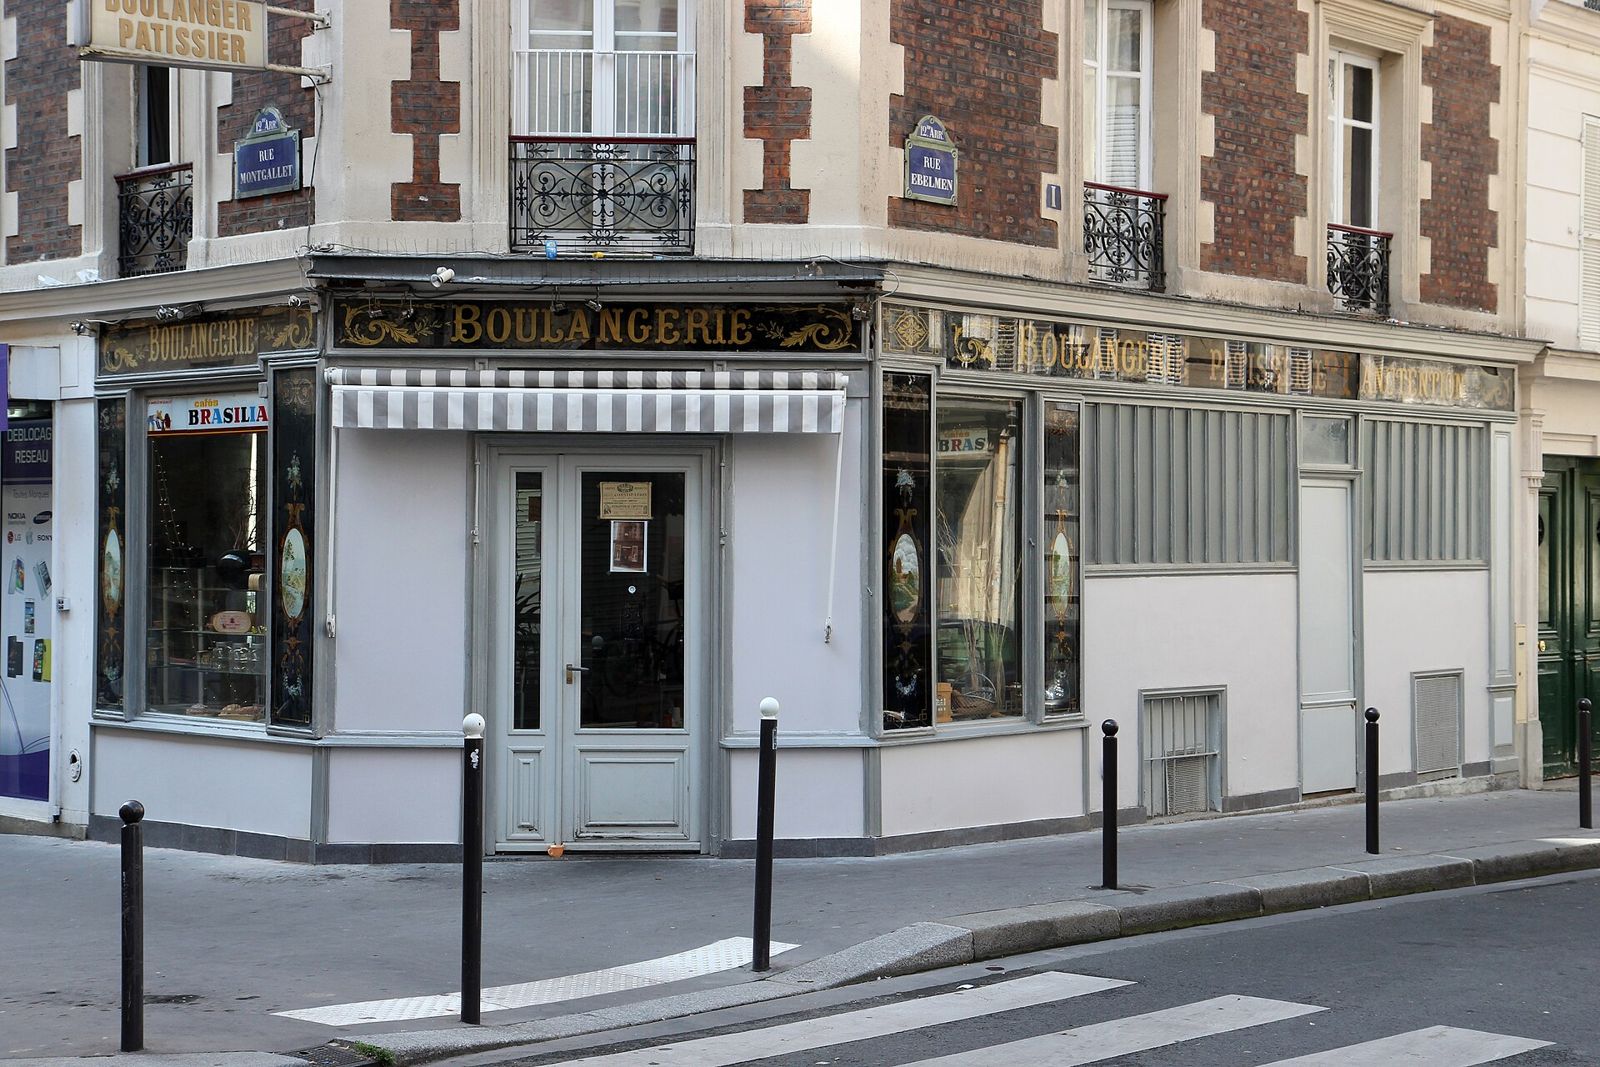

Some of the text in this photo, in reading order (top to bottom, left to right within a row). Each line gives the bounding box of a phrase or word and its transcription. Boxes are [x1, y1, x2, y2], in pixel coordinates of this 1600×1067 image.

[118, 17, 246, 64] PATISSIER
[259, 148, 275, 162] RUE
[923, 155, 941, 171] RUE
[240, 164, 294, 185] MONTGALLET
[911, 172, 954, 192] EBELMEN
[450, 303, 754, 345] BOULANGERIE
[149, 317, 255, 363] BOULANGERIE
[188, 405, 269, 426] BRASILIA
[14, 450, 49, 464] RESEAU
[8, 512, 26, 520] NOKIA
